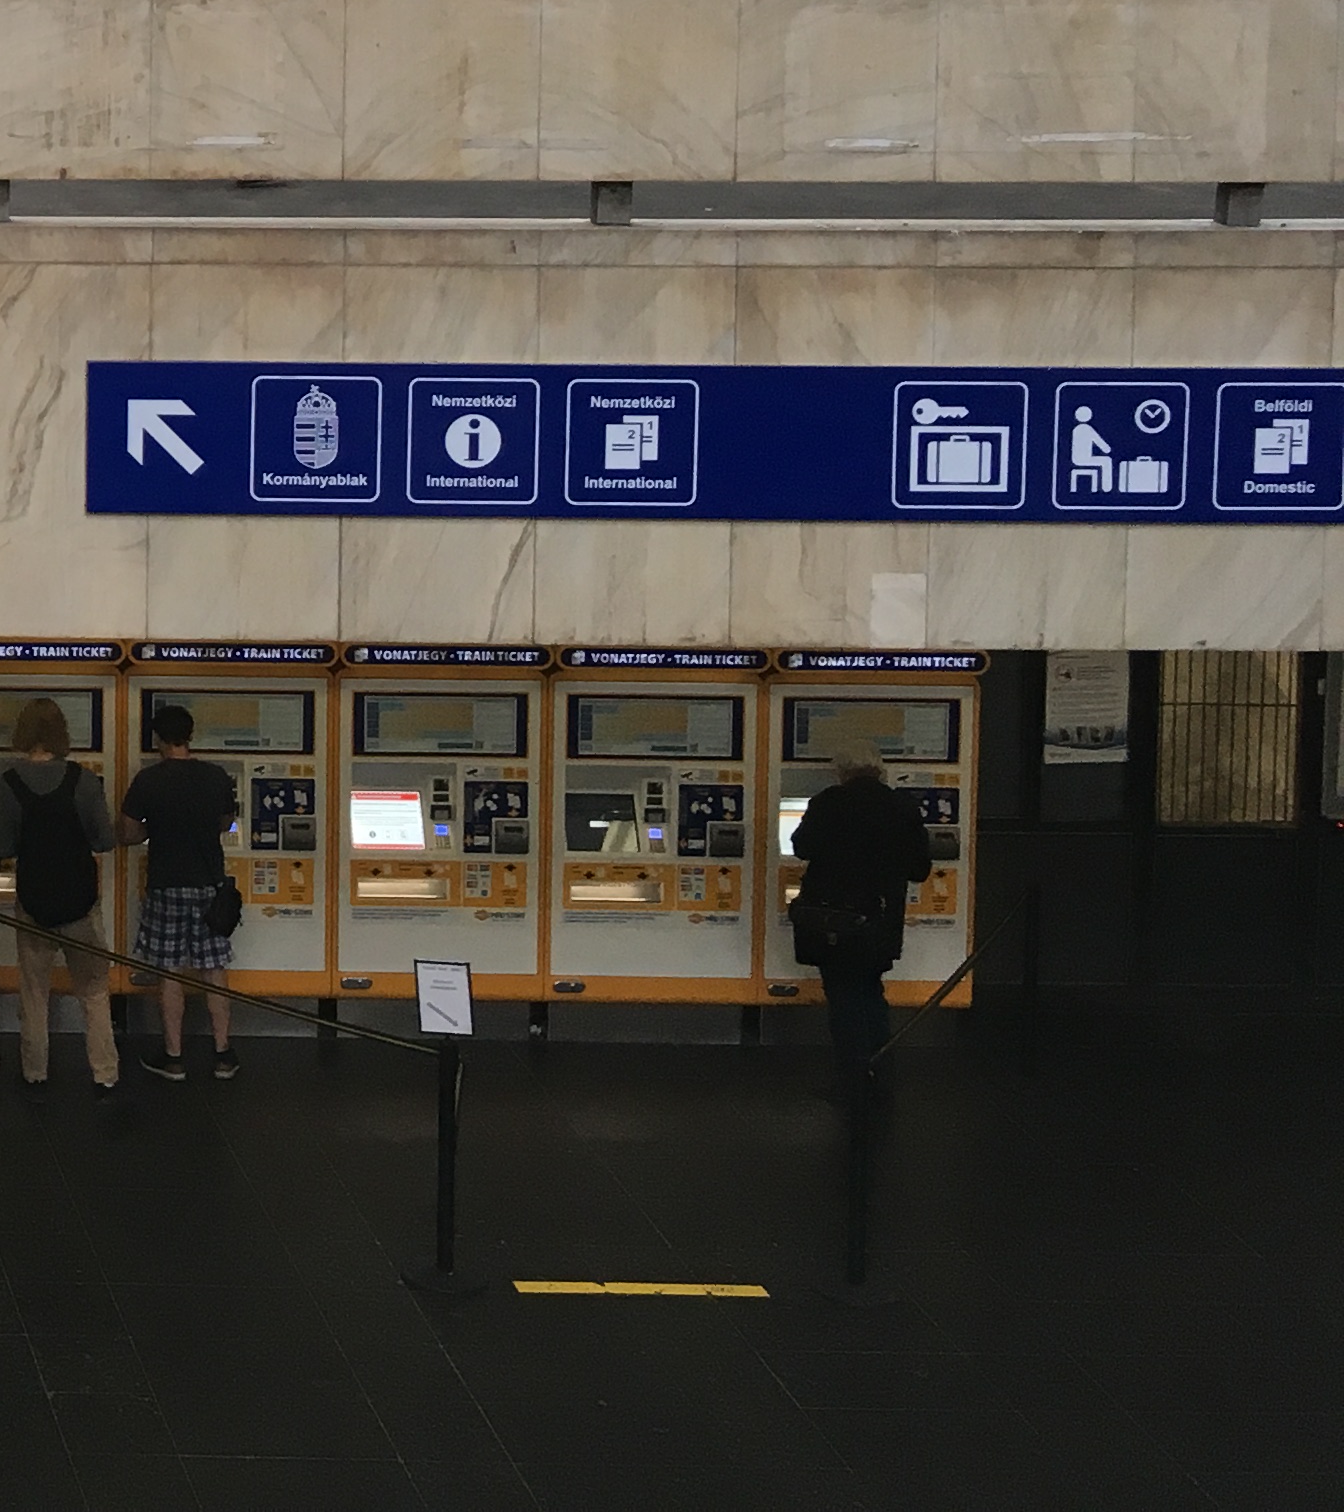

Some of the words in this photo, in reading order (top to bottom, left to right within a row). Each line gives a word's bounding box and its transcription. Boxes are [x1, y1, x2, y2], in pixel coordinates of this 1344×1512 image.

[431, 393, 517, 408] Nemzetközi
[590, 394, 676, 410] Nemzetközi
[1254, 399, 1312, 413] Belföldi
[262, 472, 368, 490] Kormányablak
[426, 474, 518, 488] International
[584, 476, 676, 490] International
[1244, 480, 1316, 494] Domestic
[32, 646, 70, 658] TRAIN
[72, 646, 112, 658] TICKET
[161, 648, 233, 660] VONATJEGY
[242, 648, 280, 660] TRAIN
[282, 648, 324, 660] TICKET
[374, 650, 446, 662] VONATJEGY
[456, 650, 495, 662] TRAIN
[497, 650, 540, 662] TICKET
[591, 652, 665, 664] VONATJEGY
[674, 652, 712, 664] TRAIN
[714, 652, 758, 664] TICKET
[810, 656, 883, 667] VONATJEGY
[892, 656, 932, 667] TRAIN
[934, 656, 976, 667] TICKET
